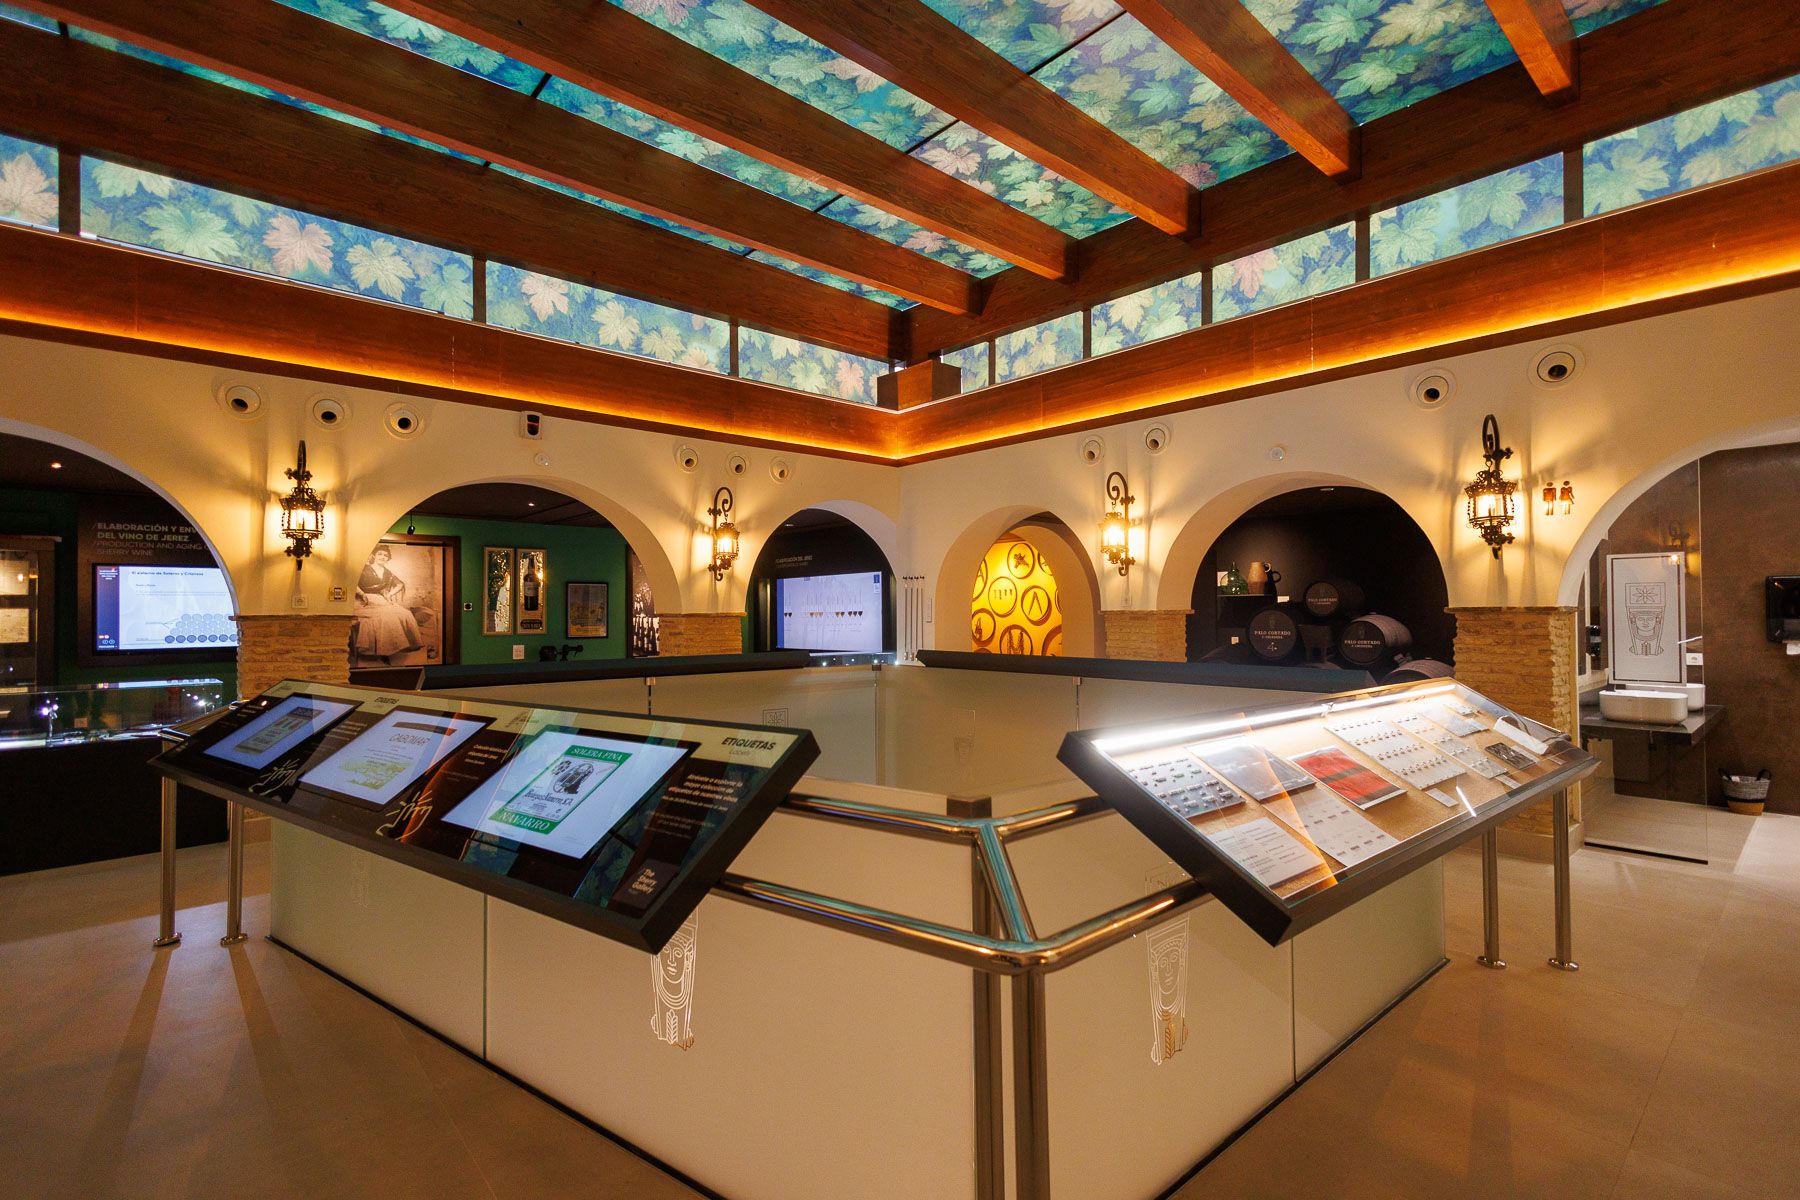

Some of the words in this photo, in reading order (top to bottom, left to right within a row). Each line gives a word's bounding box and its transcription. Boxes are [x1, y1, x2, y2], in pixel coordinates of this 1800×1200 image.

[721, 737, 776, 750] ETIQUETAS
[572, 748, 603, 758] SOLERA
[603, 751, 622, 761] FINA
[501, 812, 550, 830] NAVARRO
